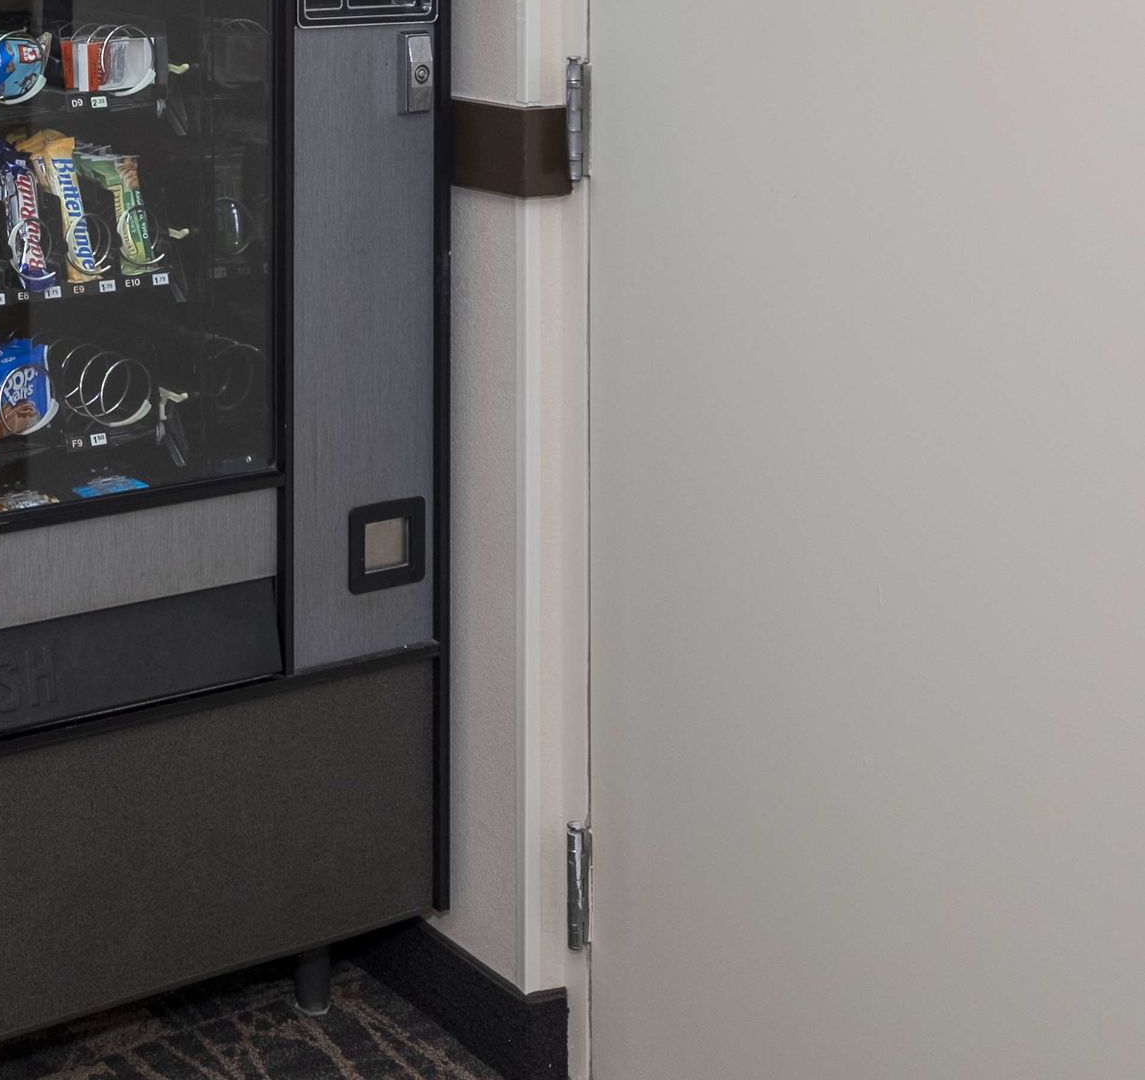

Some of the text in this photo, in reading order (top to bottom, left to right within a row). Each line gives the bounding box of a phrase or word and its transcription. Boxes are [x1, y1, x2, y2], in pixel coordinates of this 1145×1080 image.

[71, 99, 83, 107] D9
[15, 172, 47, 271] Baby Ruth
[125, 278, 140, 287] E10
[73, 286, 85, 294] E9
[72, 439, 83, 448] F9
